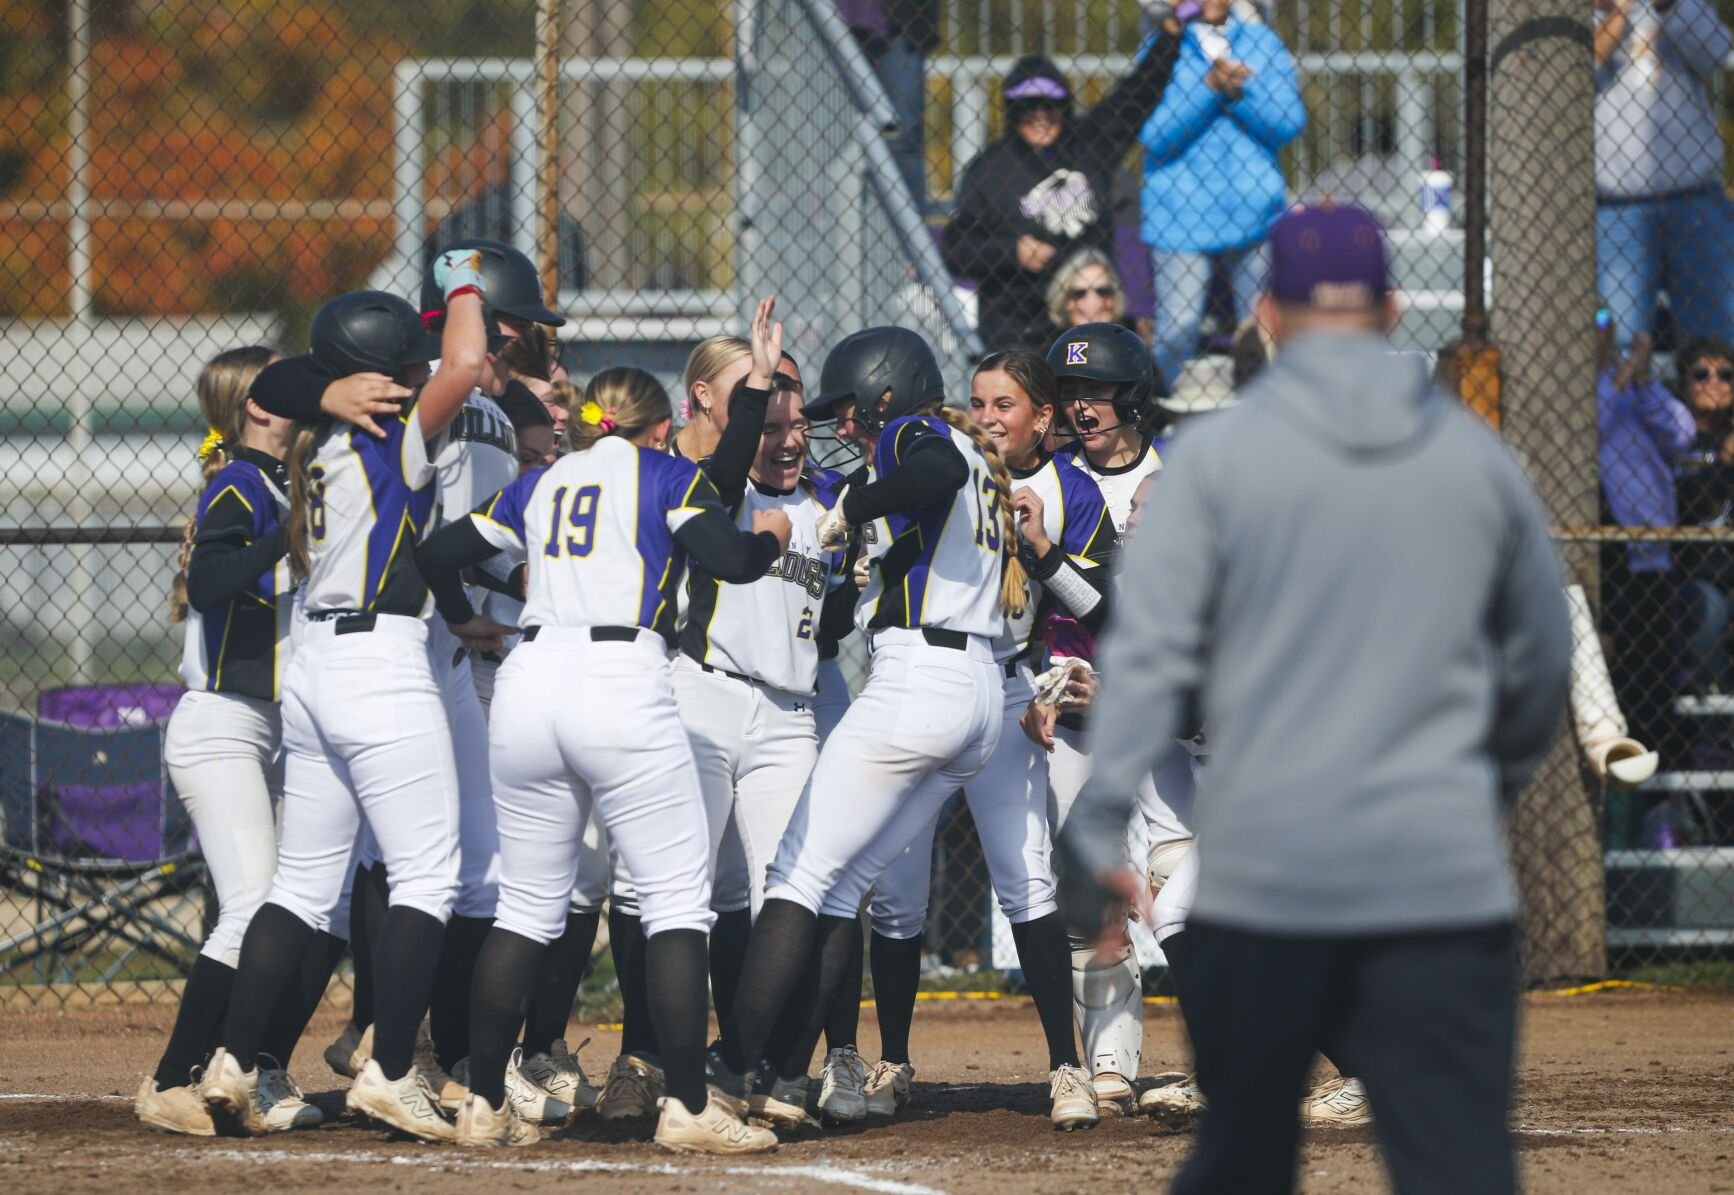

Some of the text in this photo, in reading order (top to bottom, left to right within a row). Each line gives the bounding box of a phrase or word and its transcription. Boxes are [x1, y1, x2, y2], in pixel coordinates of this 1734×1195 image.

[1066, 341, 1089, 365] K
[544, 483, 603, 560] 19
[973, 465, 1002, 555] 13
[796, 605, 813, 640] 2
